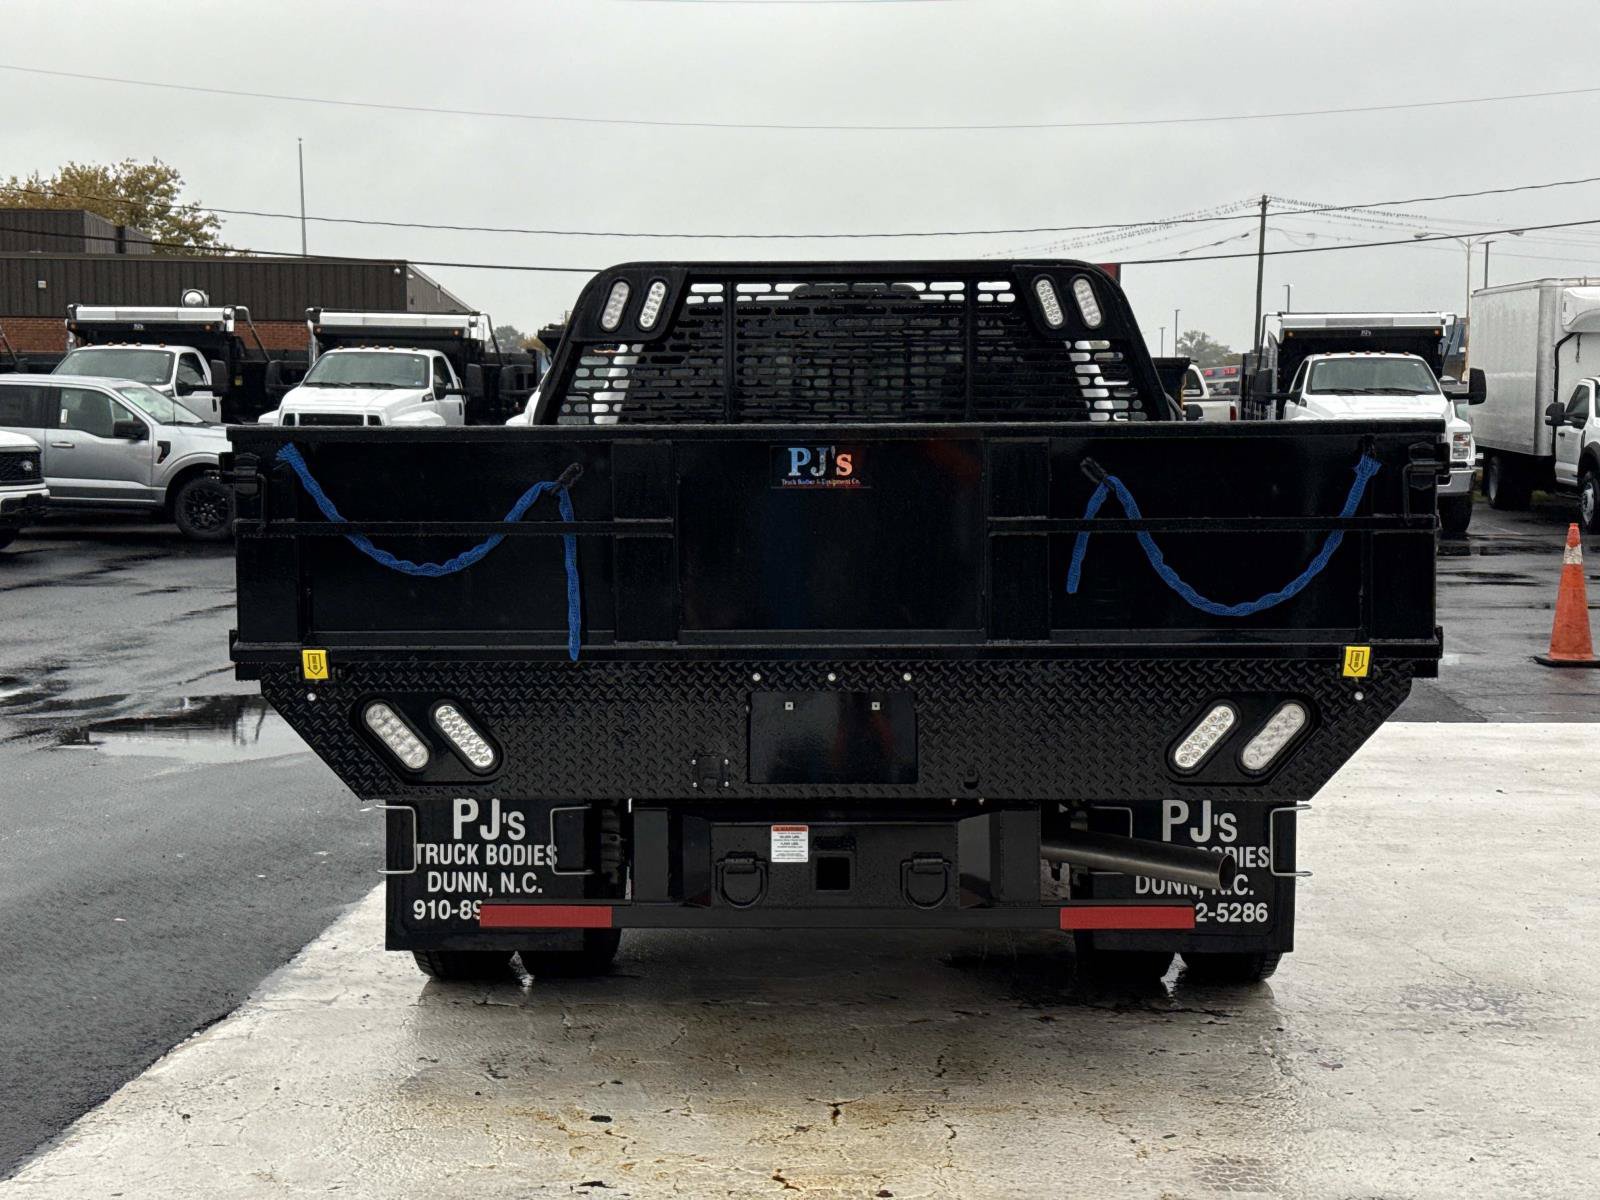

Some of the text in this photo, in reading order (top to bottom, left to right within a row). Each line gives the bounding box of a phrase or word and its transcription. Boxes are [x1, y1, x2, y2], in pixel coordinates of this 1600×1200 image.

[788, 445, 853, 477] PJ's
[453, 798, 526, 841] PJ's
[1162, 799, 1238, 843] PJ's
[415, 843, 558, 866] TRUCK BODIES
[427, 871, 543, 896] DUNN, N.C.
[1211, 874, 1255, 896] .C.
